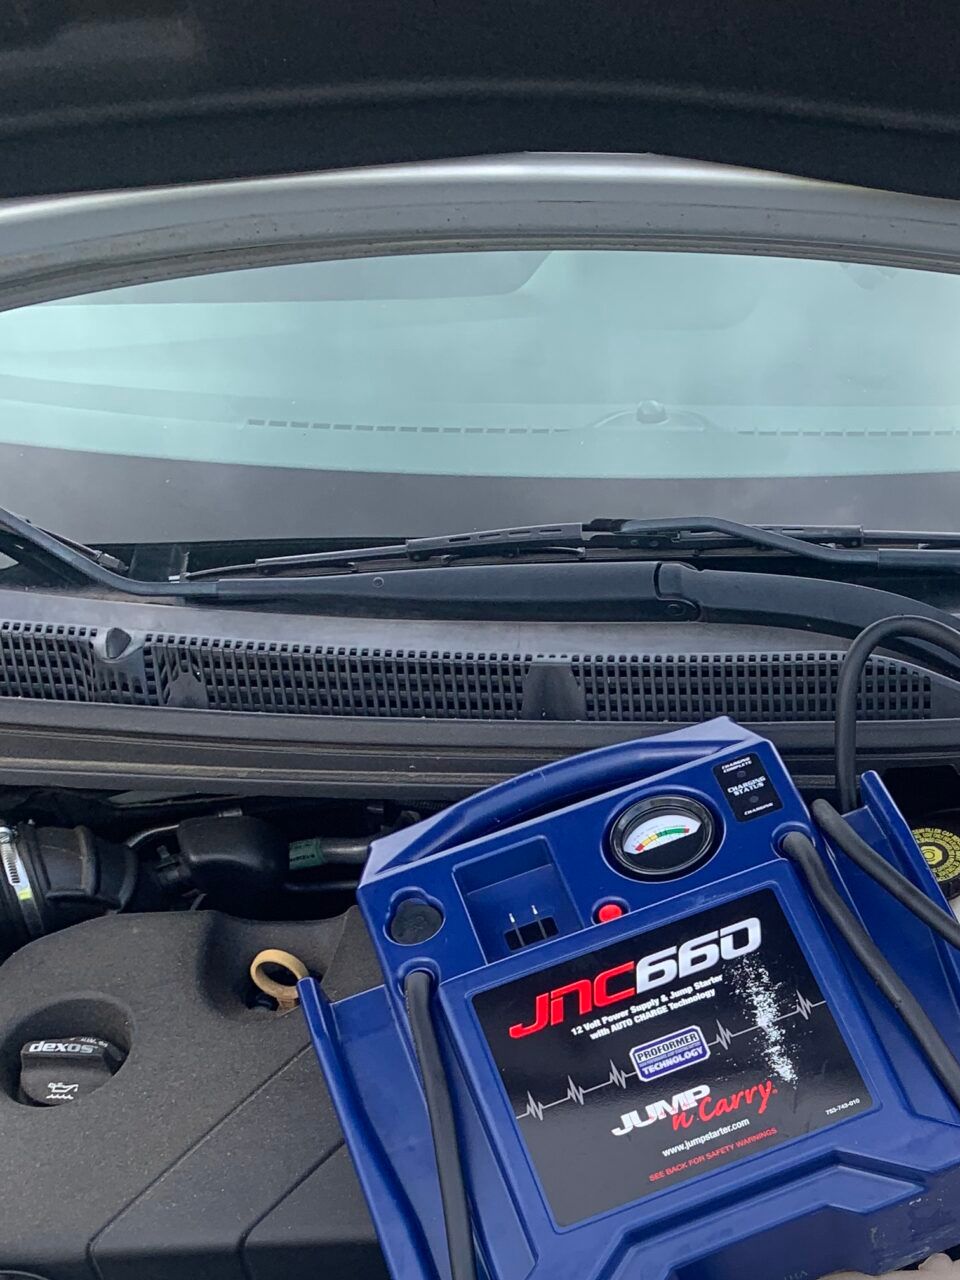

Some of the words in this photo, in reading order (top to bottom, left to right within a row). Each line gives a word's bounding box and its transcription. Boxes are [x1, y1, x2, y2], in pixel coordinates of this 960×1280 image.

[727, 775, 766, 793] CHARGING
[733, 782, 764, 796] STATUS
[744, 802, 774, 816] CHARGING
[570, 1025, 584, 1036] 12
[582, 1018, 602, 1031] Volt
[601, 1009, 629, 1024] Power
[630, 998, 660, 1014] Supply
[660, 994, 669, 1002] &
[669, 986, 694, 999] Jump
[693, 974, 724, 990] Starter
[589, 1027, 611, 1040] with
[610, 1018, 634, 1033] AUTO
[633, 1004, 669, 1023] CHARGE
[667, 988, 716, 1010] Technology
[28, 1040, 94, 1054] dexos
[637, 1033, 698, 1061] PROFORMER
[641, 1045, 704, 1076] TECHNOLOGY
[611, 1084, 711, 1137] JUMP
[661, 1118, 750, 1157] www.jumpstarter.com
[649, 1171, 666, 1182] SEE
[665, 1162, 688, 1176] BACK
[688, 1155, 706, 1167] FOR
[705, 1143, 735, 1160] SAFETY
[735, 1127, 778, 1149] WARNINGS
